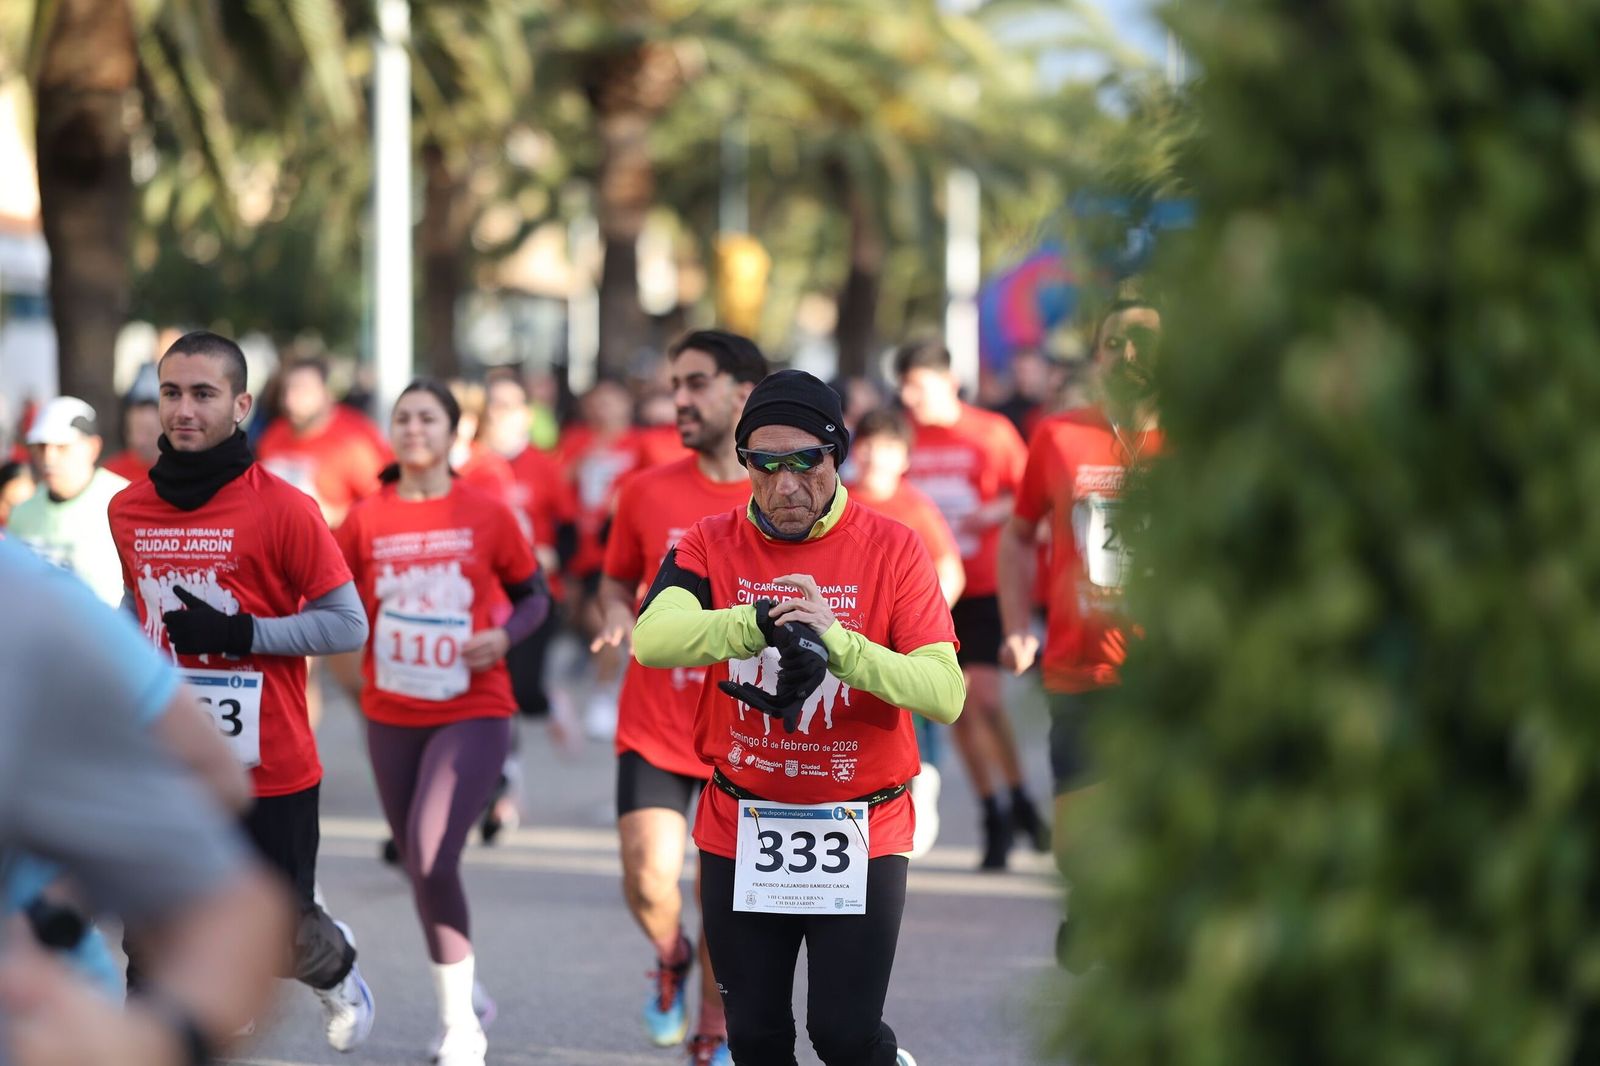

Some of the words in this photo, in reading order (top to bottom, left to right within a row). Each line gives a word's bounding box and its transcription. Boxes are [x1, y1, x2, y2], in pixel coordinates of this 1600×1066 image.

[147, 528, 185, 537] CARRERA
[186, 528, 220, 538] URBANA
[222, 529, 234, 538] DE
[134, 539, 180, 552] CIUDAD
[183, 536, 232, 552] JARDÍN
[738, 577, 751, 589] VIII
[753, 582, 798, 592] CARRERA
[816, 585, 842, 594] BANA
[844, 585, 858, 594] DE
[390, 631, 457, 668] 110
[762, 737, 768, 748] 8
[780, 738, 820, 752] febrero
[832, 741, 858, 752] 2026
[755, 830, 851, 874] 333
